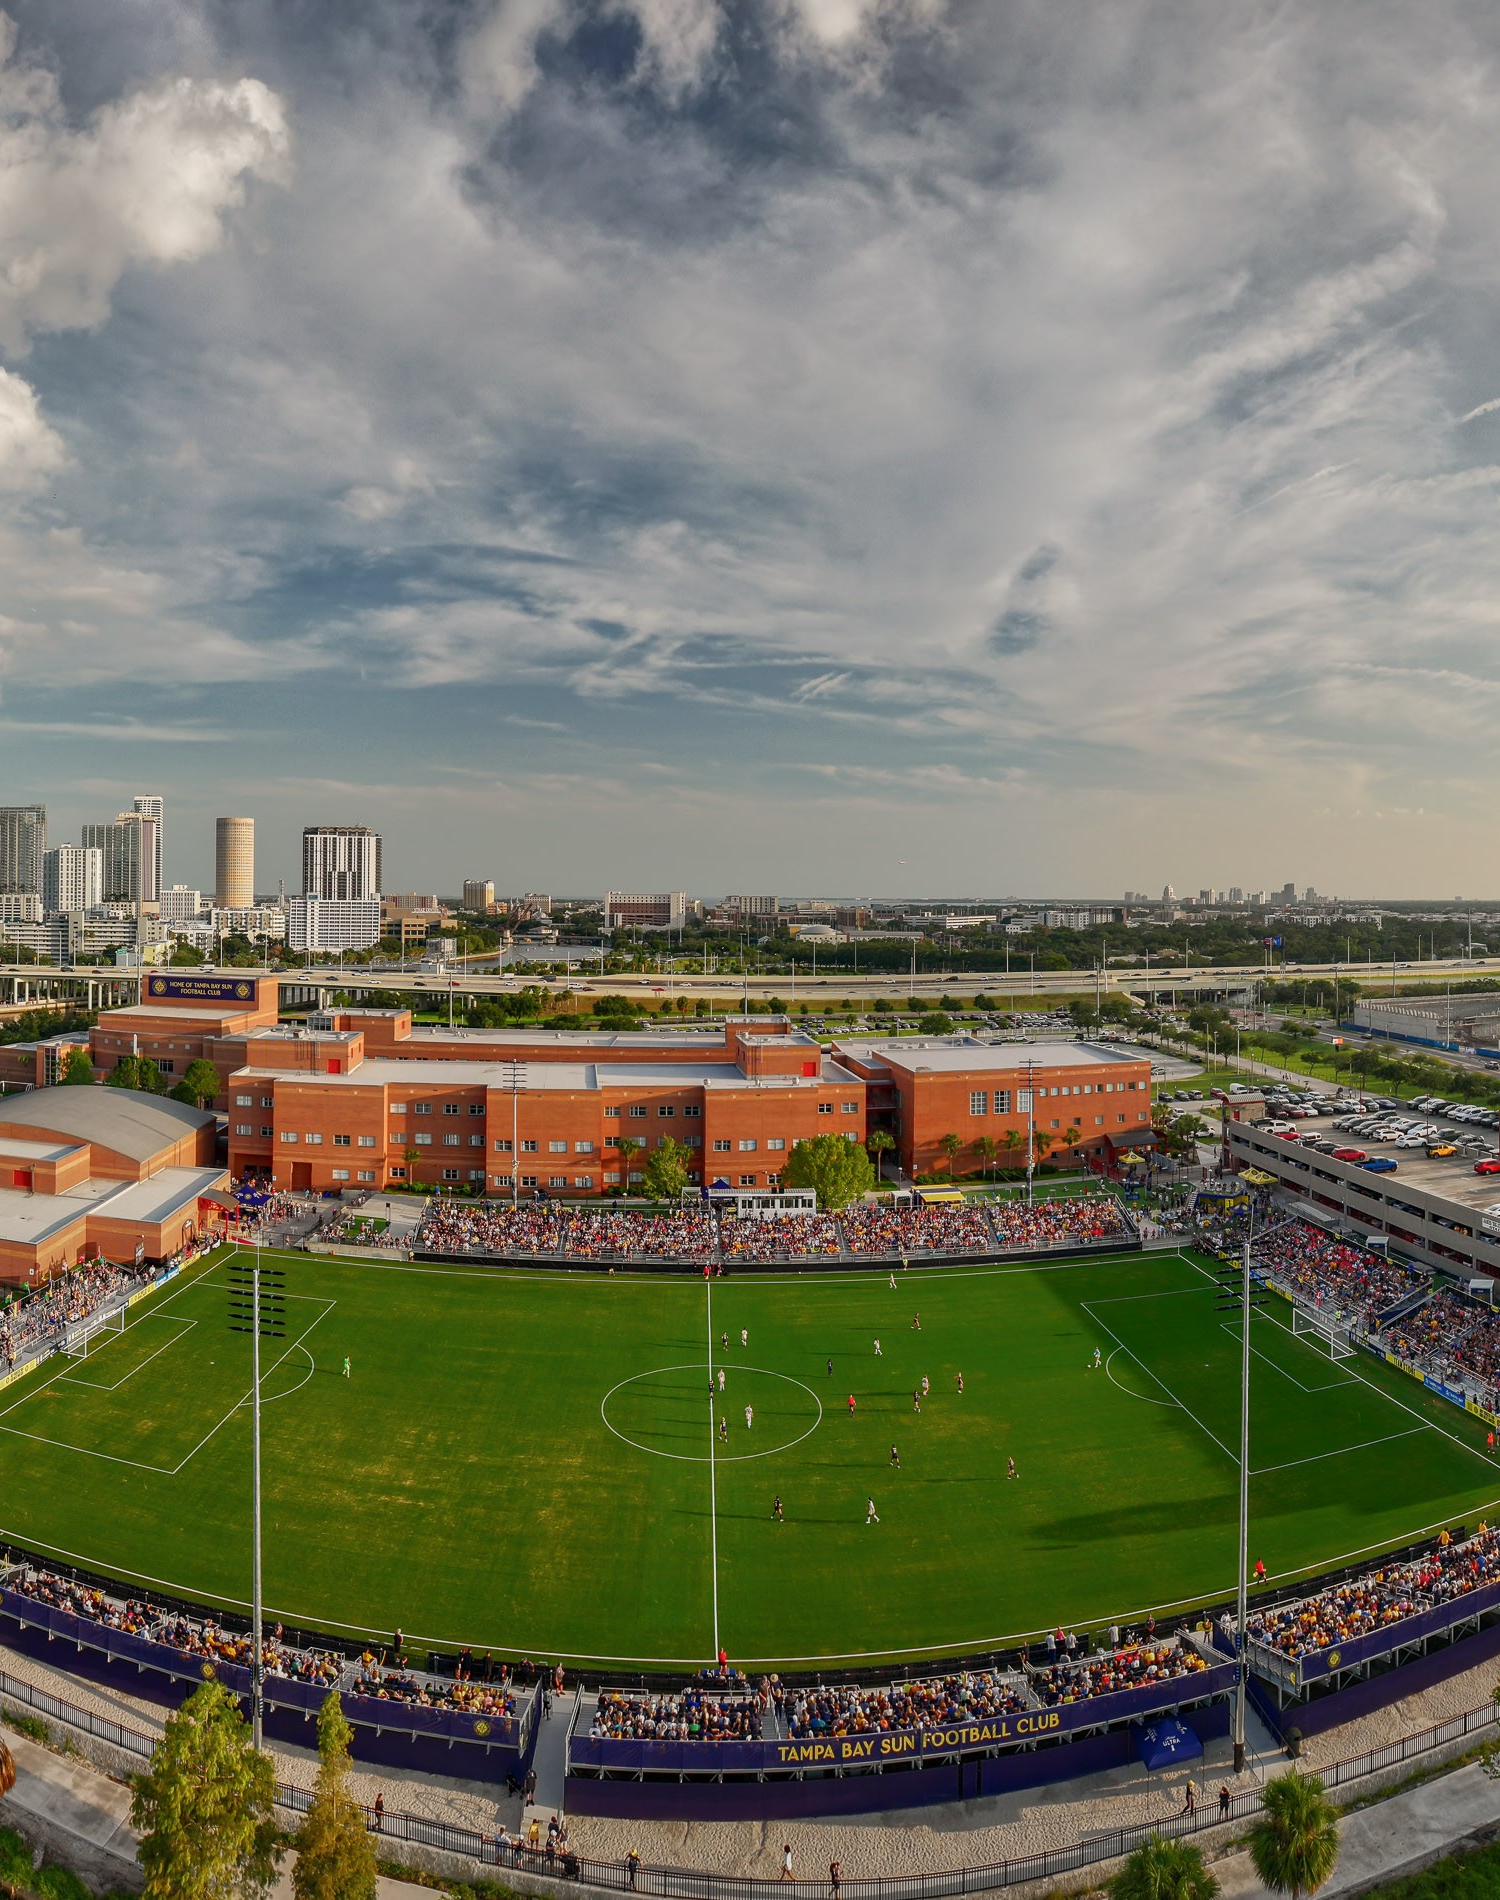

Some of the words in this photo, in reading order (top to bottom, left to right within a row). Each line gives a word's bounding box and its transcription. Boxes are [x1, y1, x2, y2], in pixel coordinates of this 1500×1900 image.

[778, 1745, 835, 1762] TAMPA
[841, 1740, 875, 1758] BAY
[880, 1734, 915, 1754] SUN
[922, 1723, 1012, 1748] FOOTBALL
[1016, 1712, 1060, 1734] CLUB
[1162, 1738, 1180, 1747] ULTRA
